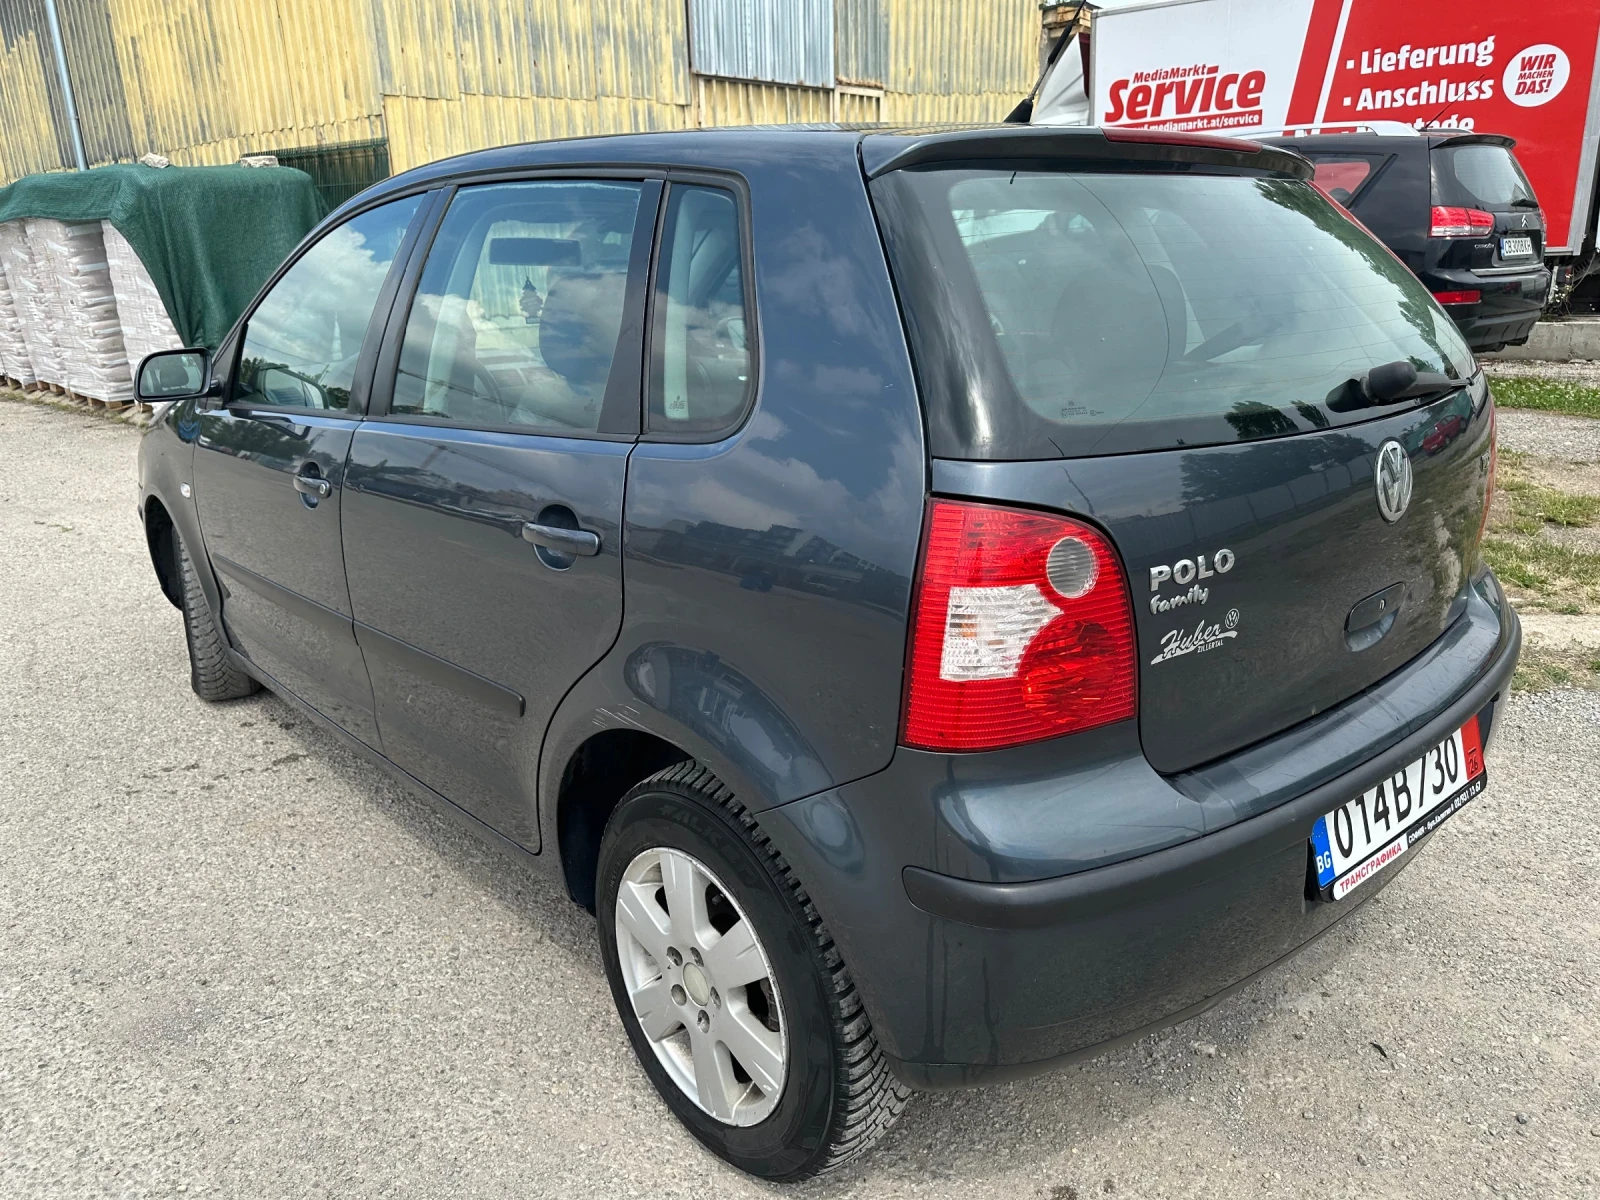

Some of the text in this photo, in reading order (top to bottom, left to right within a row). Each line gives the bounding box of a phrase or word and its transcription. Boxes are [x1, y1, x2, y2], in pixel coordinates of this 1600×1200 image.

[1360, 35, 1496, 75] Lieferung
[1519, 54, 1557, 71] WIR
[1133, 64, 1207, 84] MediaMarkt
[1517, 70, 1554, 81] MACHEN
[1104, 65, 1266, 122] Service
[1356, 79, 1494, 111] Anschluss
[1514, 79, 1552, 96] DAS!
[1150, 113, 1260, 132] mediamarkt.at/service
[1149, 548, 1235, 592] POLO
[1160, 619, 1222, 659] Huber
[1197, 639, 1224, 654] ZILLERTAL
[1468, 754, 1479, 775] 26
[1316, 851, 1331, 874] BG
[1339, 842, 1402, 893] ТРАНСГРАФИКА
